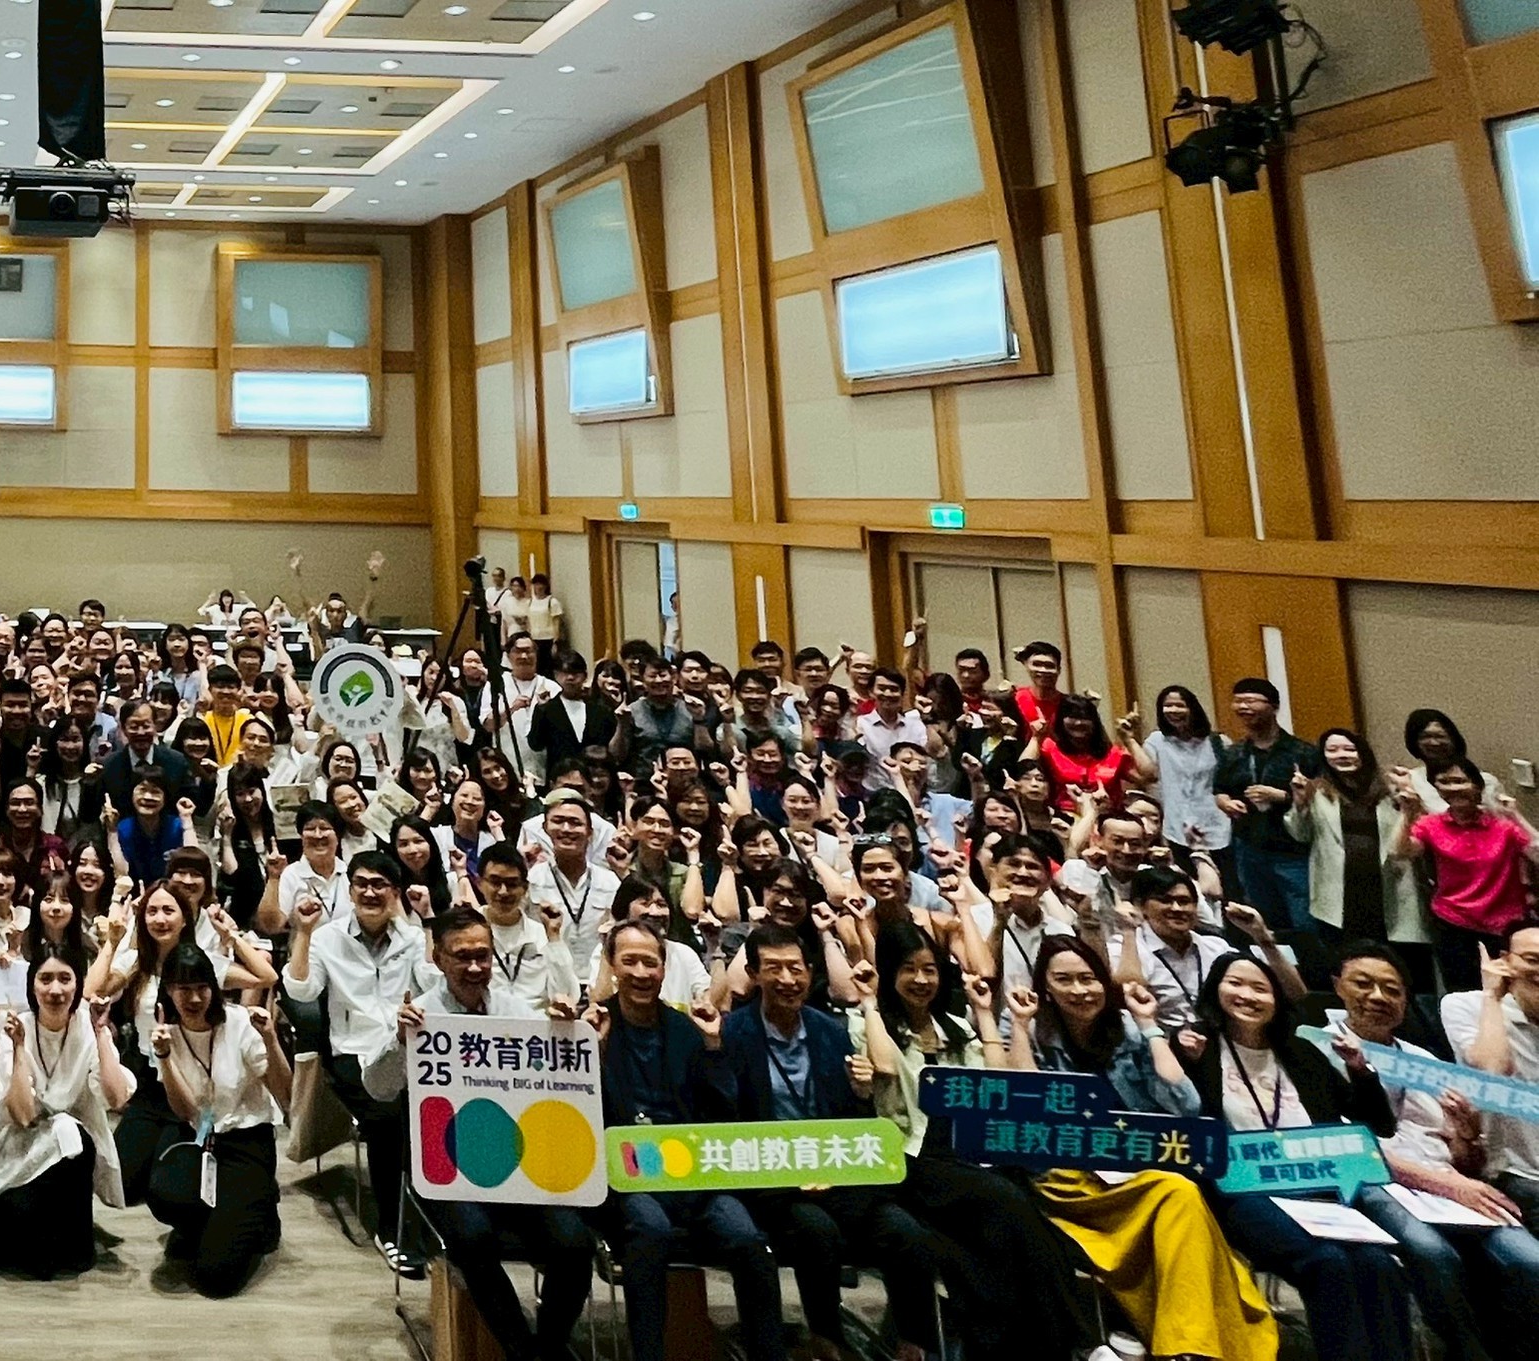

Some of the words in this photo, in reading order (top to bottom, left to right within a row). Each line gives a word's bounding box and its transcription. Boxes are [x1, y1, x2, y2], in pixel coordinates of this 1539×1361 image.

[416, 1031, 453, 1056] 20
[458, 1032, 592, 1074] 教育創新
[417, 1060, 453, 1086] 25
[462, 1075, 510, 1092] Thinking
[513, 1077, 532, 1090] BIG
[534, 1077, 546, 1090] of
[547, 1079, 595, 1095] Learning
[944, 1075, 1077, 1115] 我們一起
[700, 1132, 885, 1173] 共創教育未來
